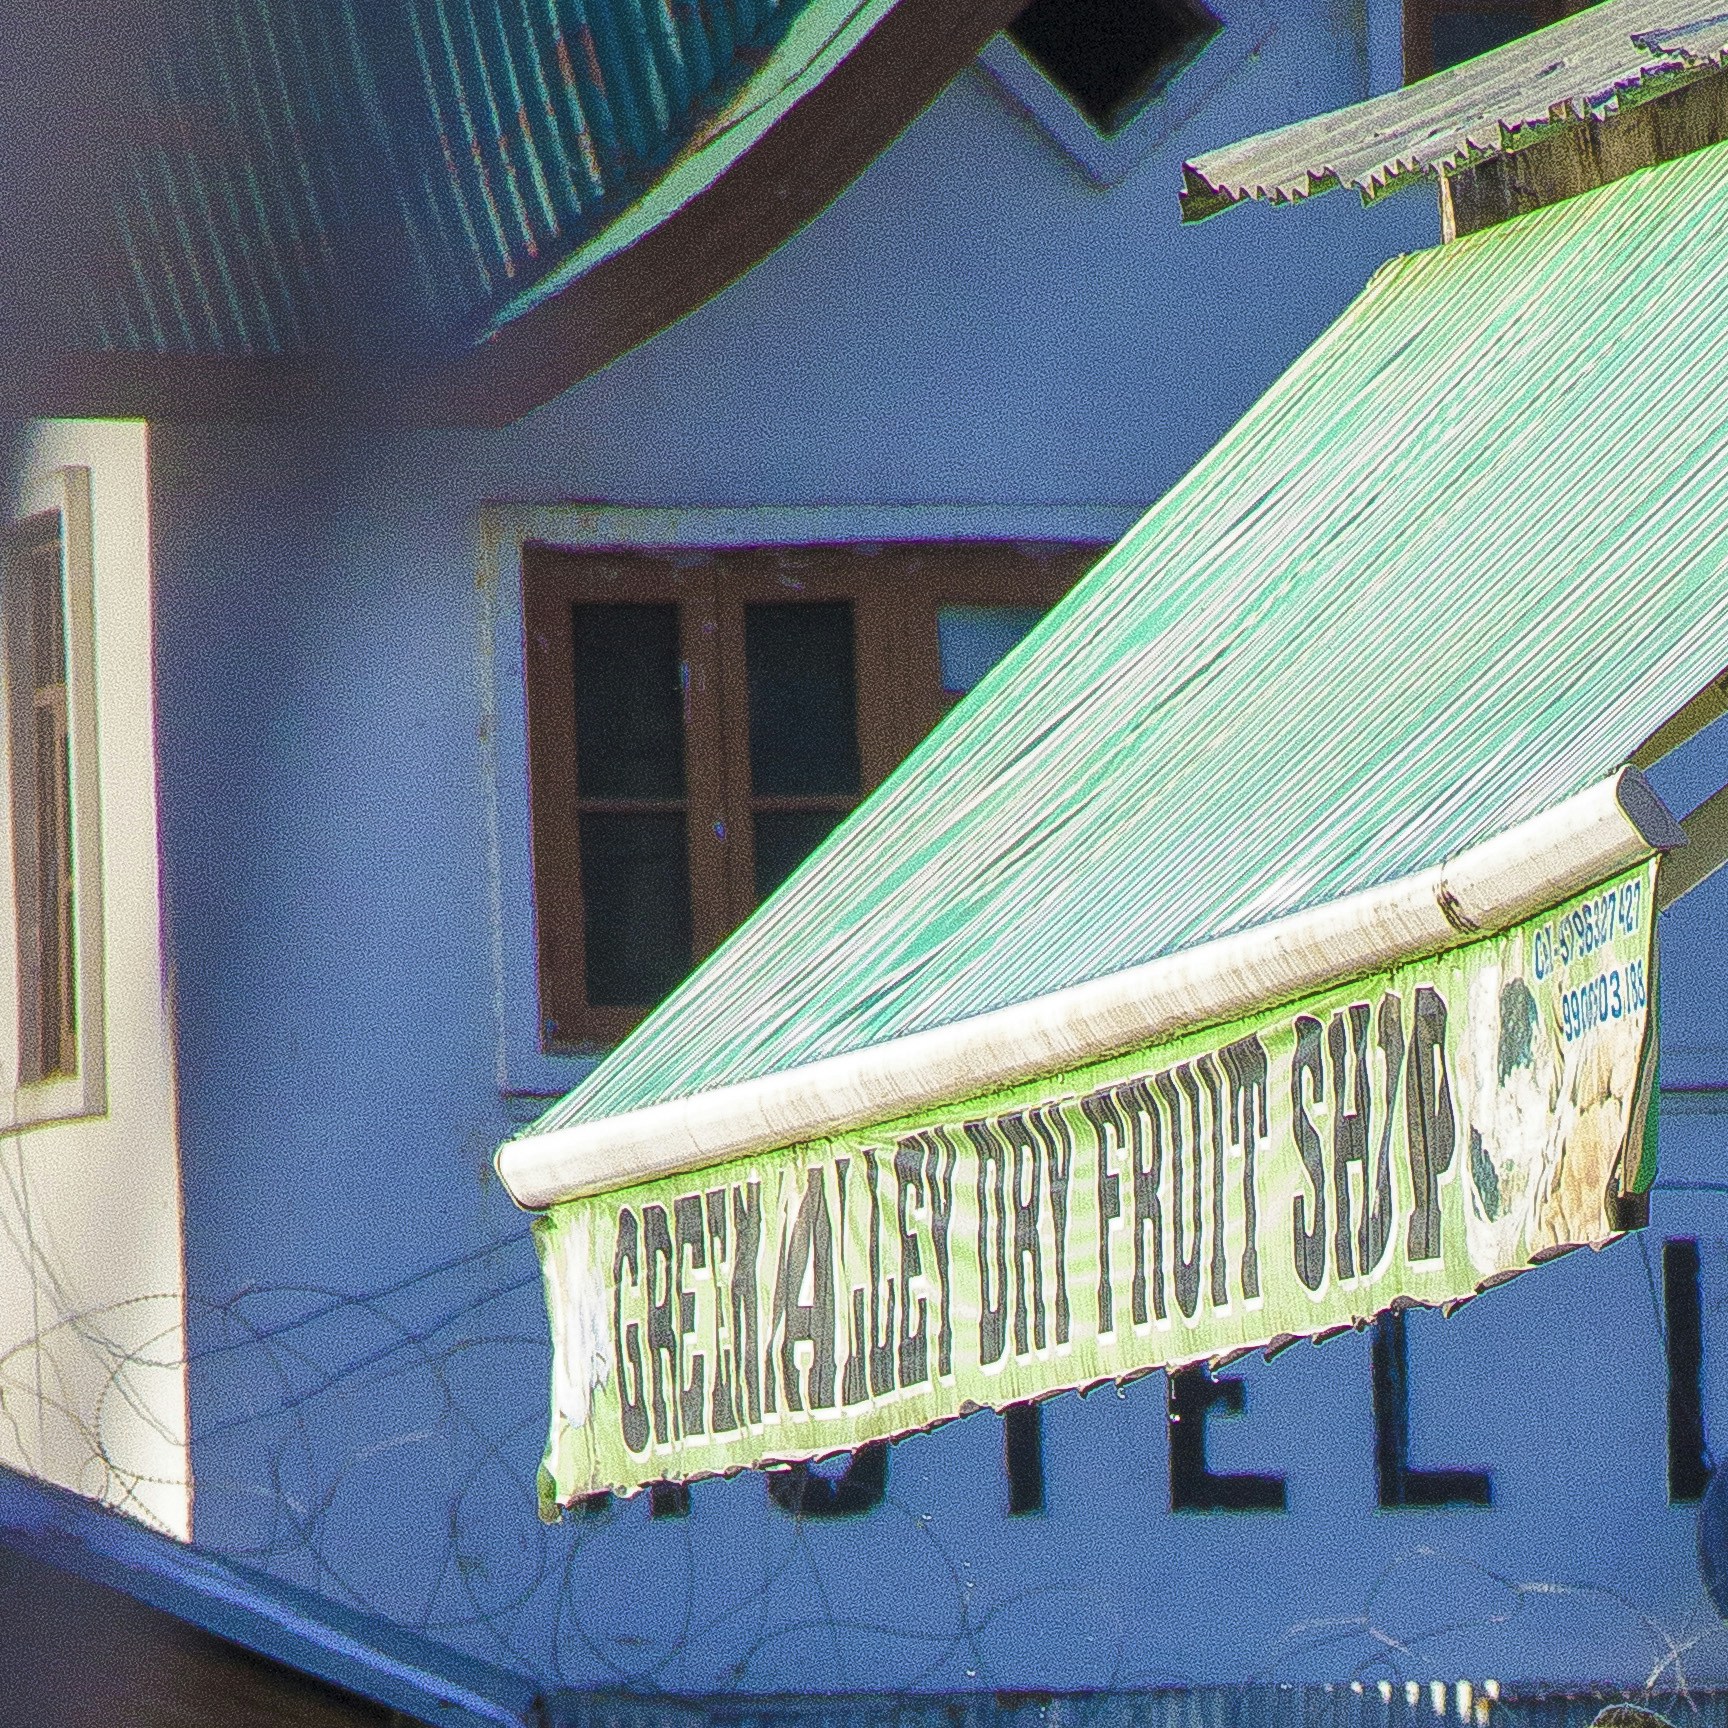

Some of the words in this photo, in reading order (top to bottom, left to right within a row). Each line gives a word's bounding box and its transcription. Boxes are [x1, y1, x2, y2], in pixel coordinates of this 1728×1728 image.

[614, 1180, 763, 1454] GREEN
[964, 1105, 1072, 1366] DRY
[1080, 1032, 1268, 1334] FRUIT
